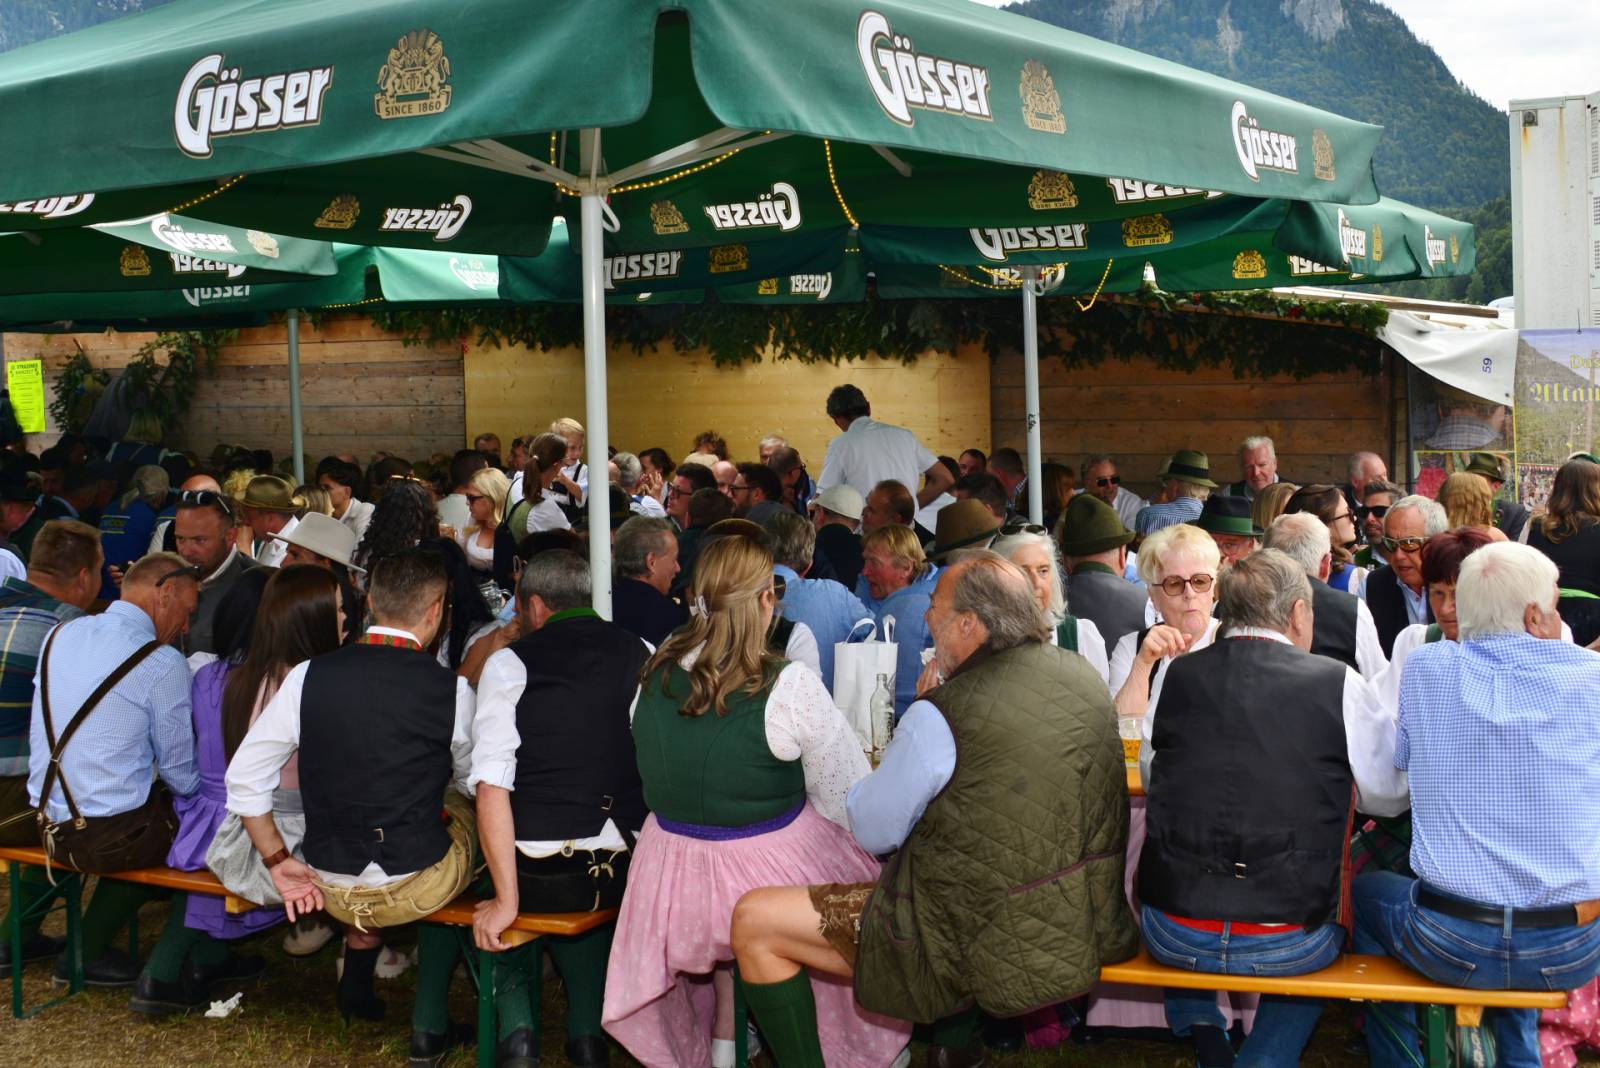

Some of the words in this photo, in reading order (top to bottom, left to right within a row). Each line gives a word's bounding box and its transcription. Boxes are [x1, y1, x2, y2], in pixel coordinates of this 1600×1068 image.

[857, 11, 992, 125] Gösser
[175, 54, 334, 157] Gösser
[385, 104, 413, 116] SINCE
[418, 101, 442, 112] 1860
[1231, 101, 1297, 180] Gösser
[603, 251, 681, 290] össer
[1482, 357, 1493, 374] 59
